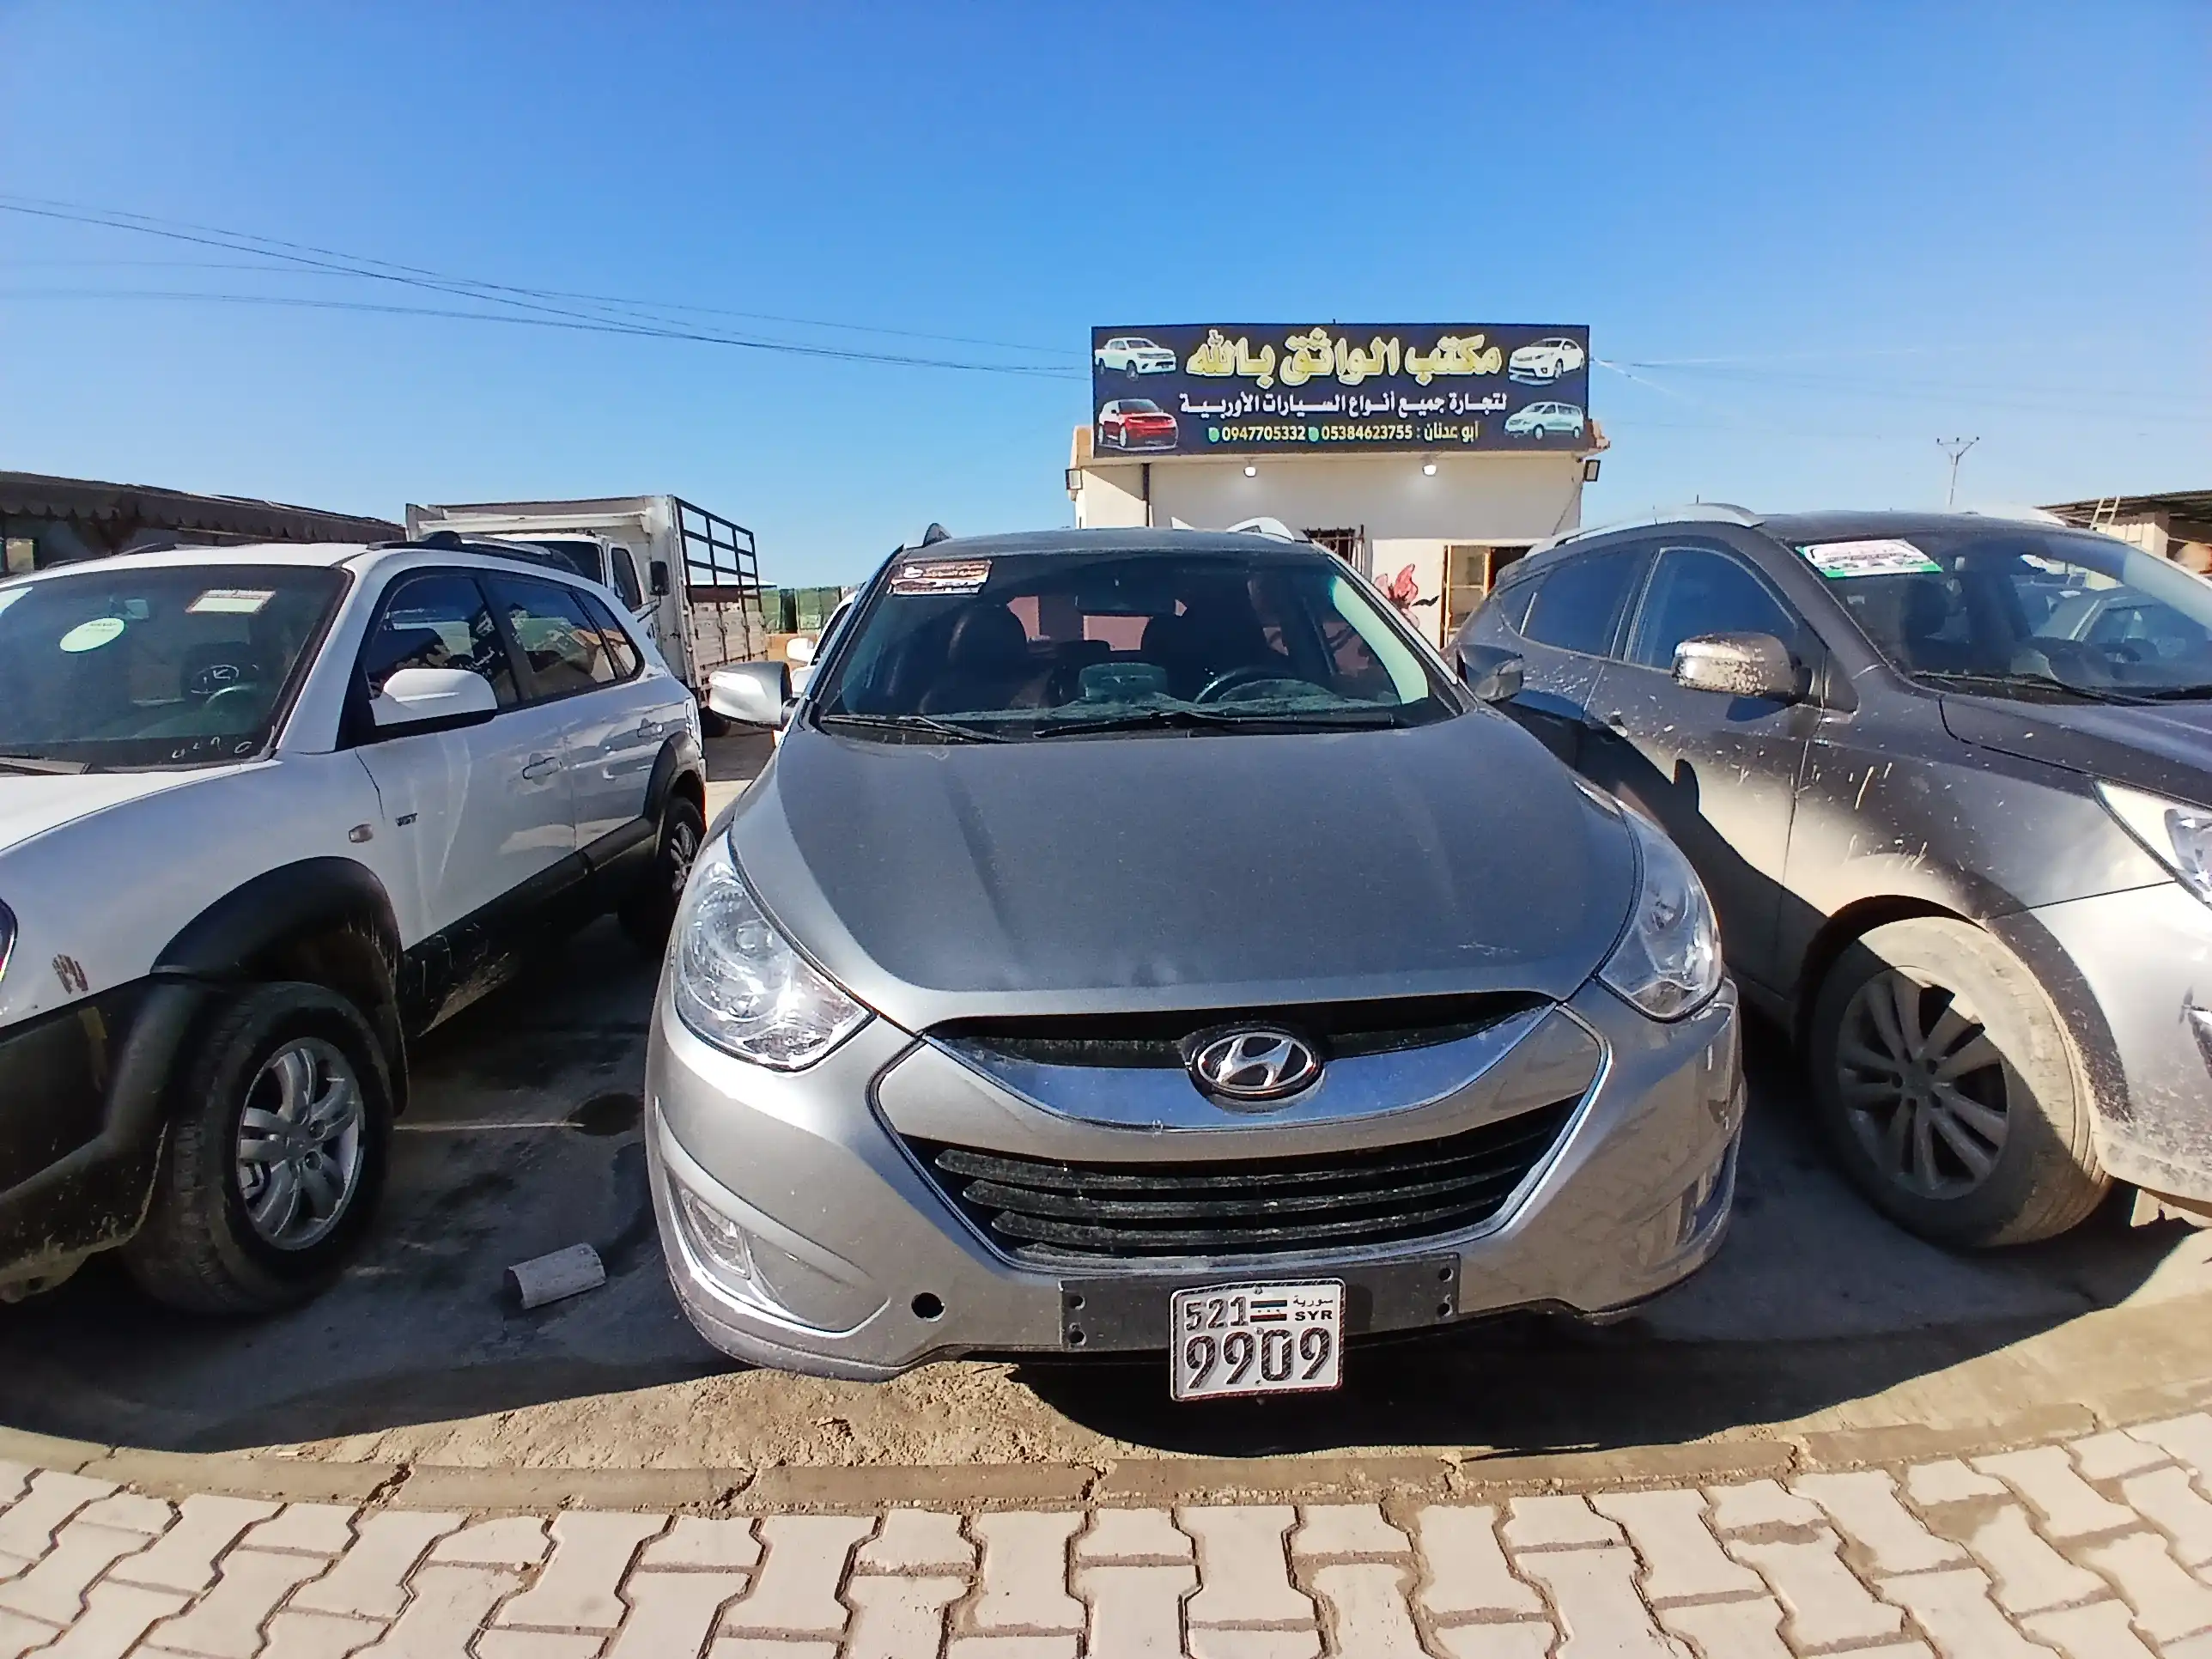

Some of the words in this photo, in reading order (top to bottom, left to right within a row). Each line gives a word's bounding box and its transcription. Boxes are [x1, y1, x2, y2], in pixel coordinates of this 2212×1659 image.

[1186, 329, 1275, 389] بالله
[1279, 327, 1400, 386] الواثق
[1405, 334, 1502, 386] مكتب
[1179, 391, 1259, 419] الأوربية
[1262, 393, 1346, 417] السيارات
[1349, 391, 1395, 417] أنواع
[1398, 397, 1445, 418] جميع
[1449, 392, 1507, 416] لتجارة
[1221, 425, 1306, 441] 0947705332
[1321, 424, 1413, 441] 05384623755
[1424, 422, 1458, 441] عدنان
[1292, 1295, 1334, 1308] سورية
[1185, 1297, 1249, 1331] 521
[1295, 1310, 1333, 1322] SYR
[1185, 1327, 1332, 1389] 9909
